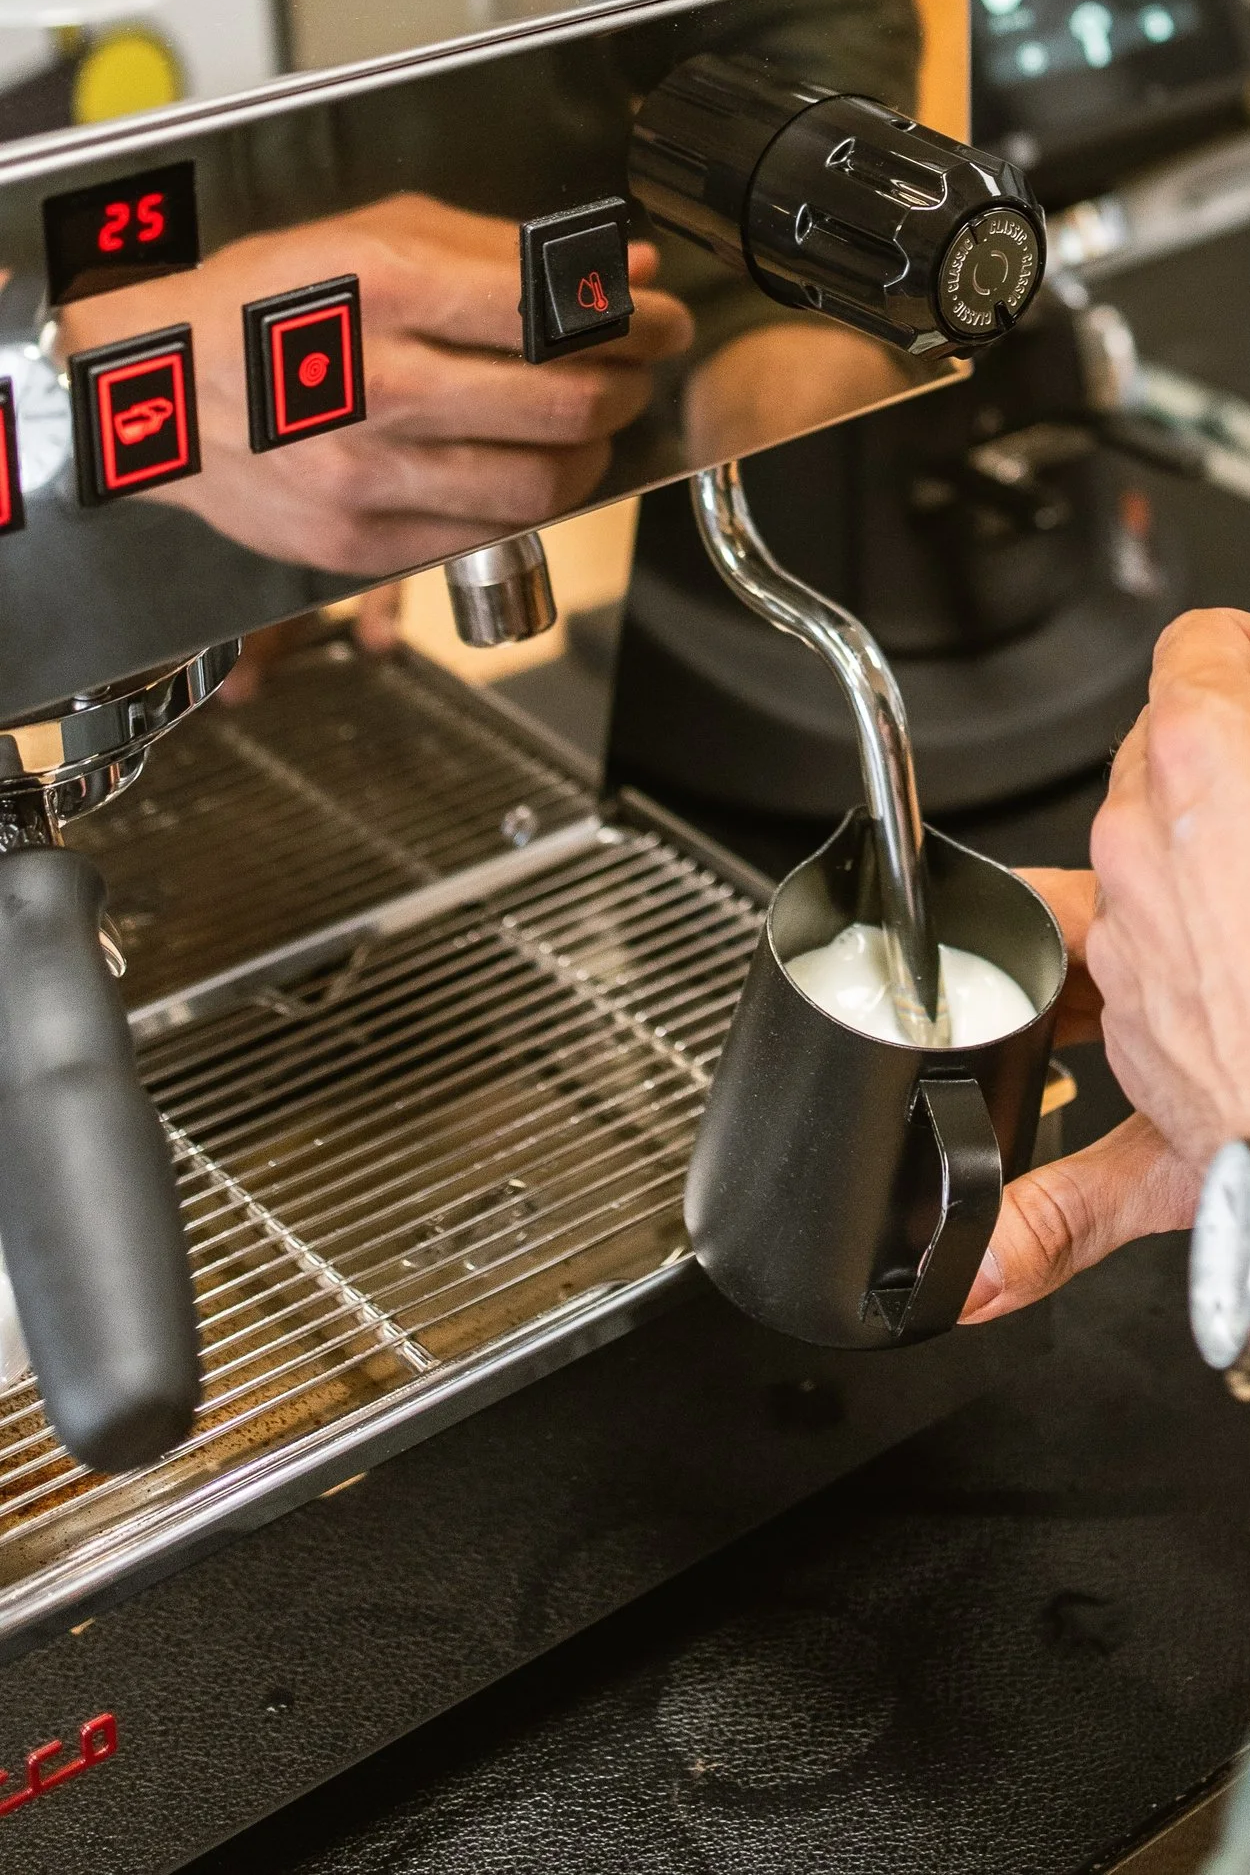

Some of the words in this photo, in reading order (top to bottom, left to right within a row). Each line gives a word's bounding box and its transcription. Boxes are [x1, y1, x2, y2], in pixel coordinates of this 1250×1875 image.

[98, 192, 164, 253] 25
[989, 220, 1028, 246] CLASSIC
[947, 238, 974, 293] CLASSIC
[1007, 253, 1033, 307] CLASSIC
[952, 300, 992, 326] CLASSIC
